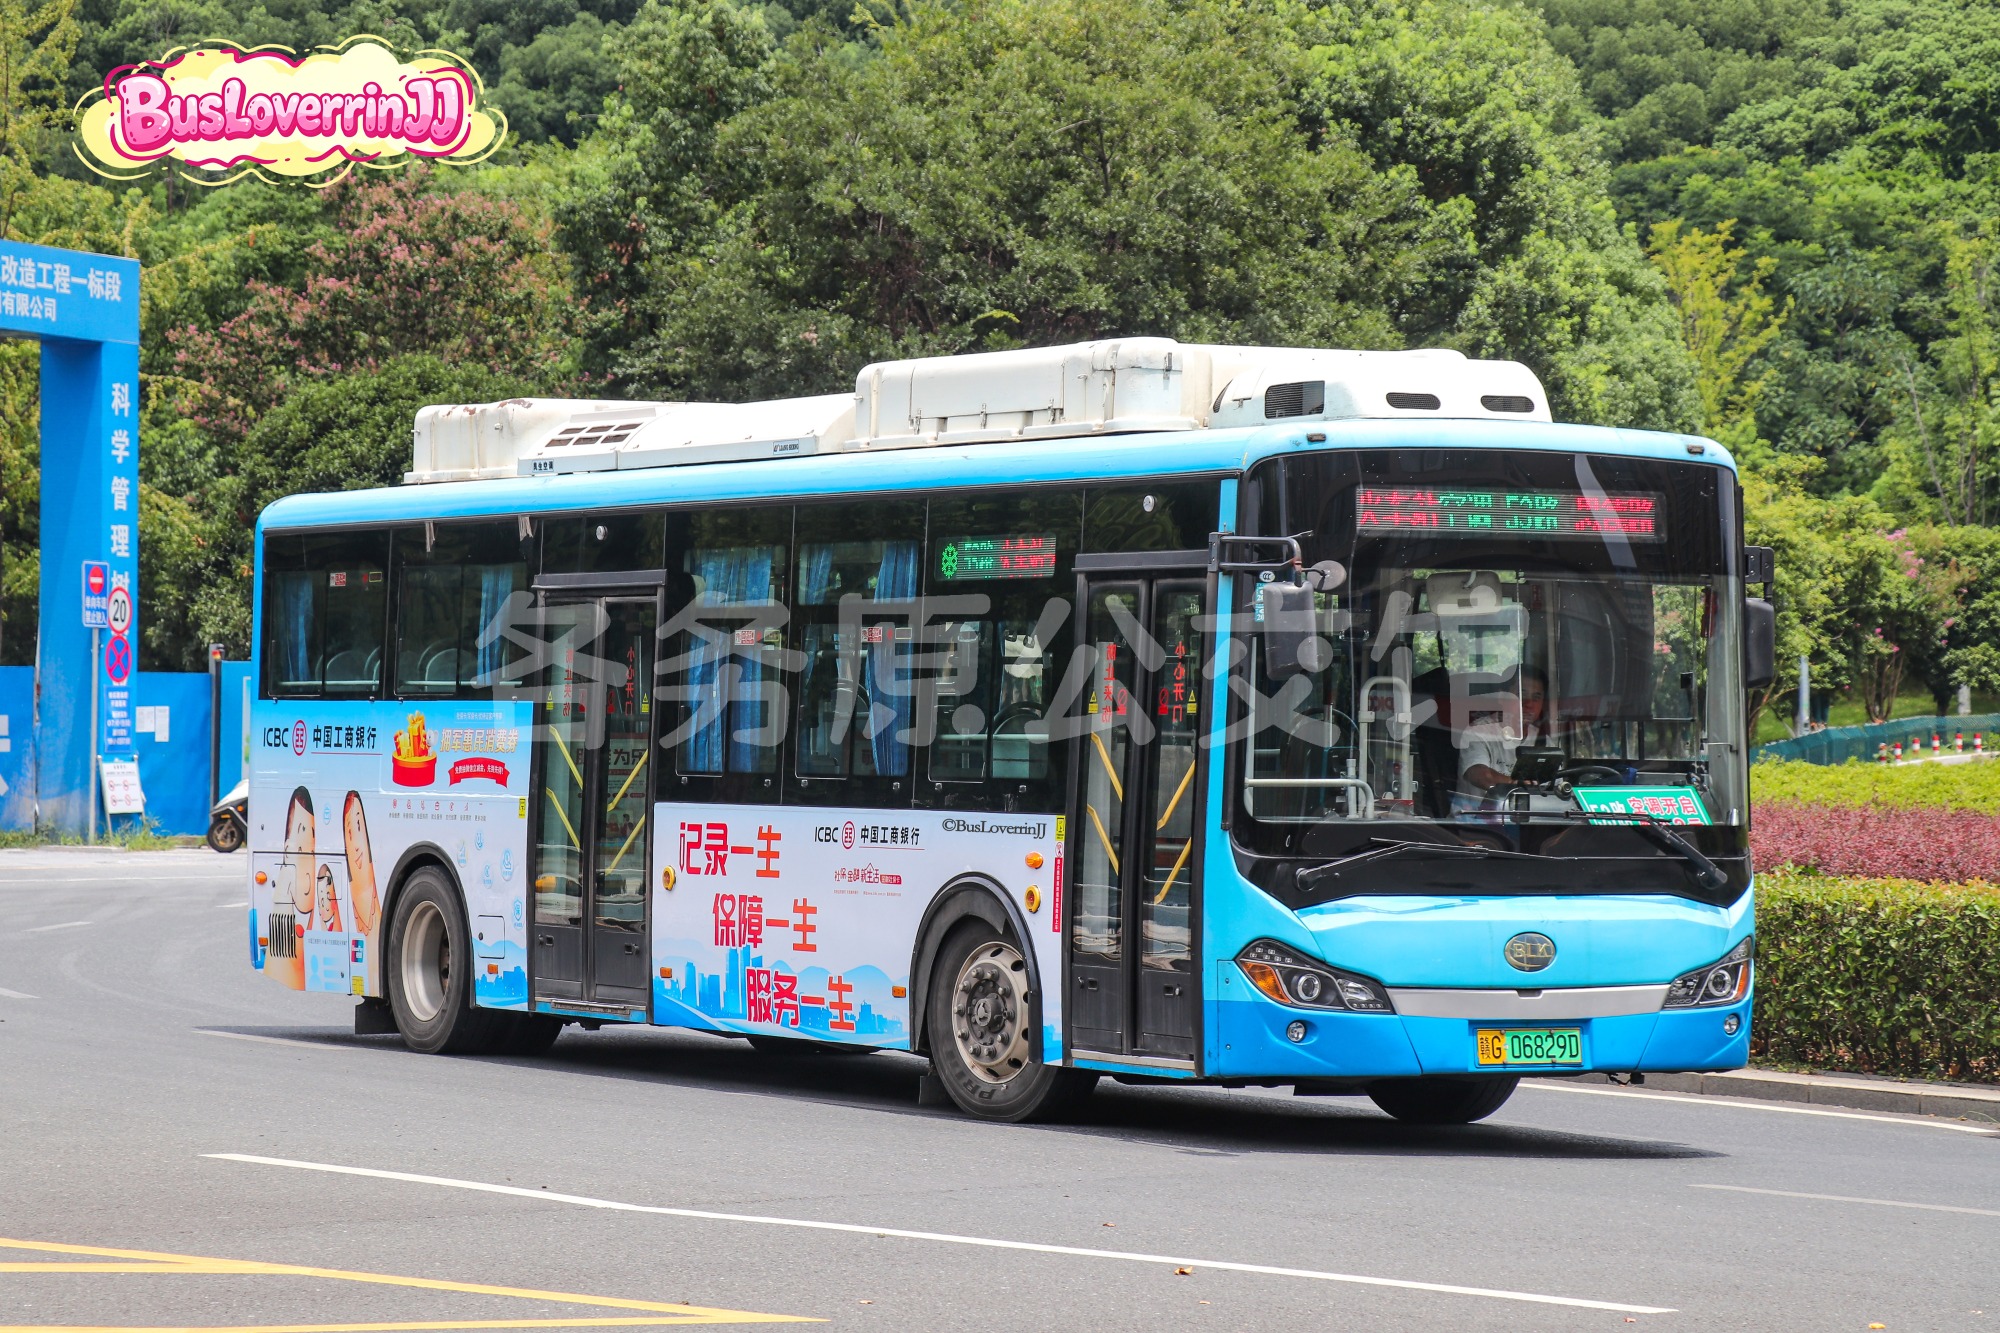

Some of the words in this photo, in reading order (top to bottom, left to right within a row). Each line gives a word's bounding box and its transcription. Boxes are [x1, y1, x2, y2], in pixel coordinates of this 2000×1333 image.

[1, 255, 122, 302] 改造工程一标段
[113, 599, 126, 622] 20
[263, 727, 289, 748] ICBC
[313, 724, 377, 750] 中国工商银行
[440, 727, 519, 754] 拥军惠民消费券
[1627, 796, 1698, 816] 空调开启
[814, 826, 839, 843] ICBC
[860, 824, 920, 846] 中国工商银行
[679, 821, 782, 879] 记录一生
[712, 892, 818, 952] 保障一生
[745, 967, 857, 1032] 服务一生
